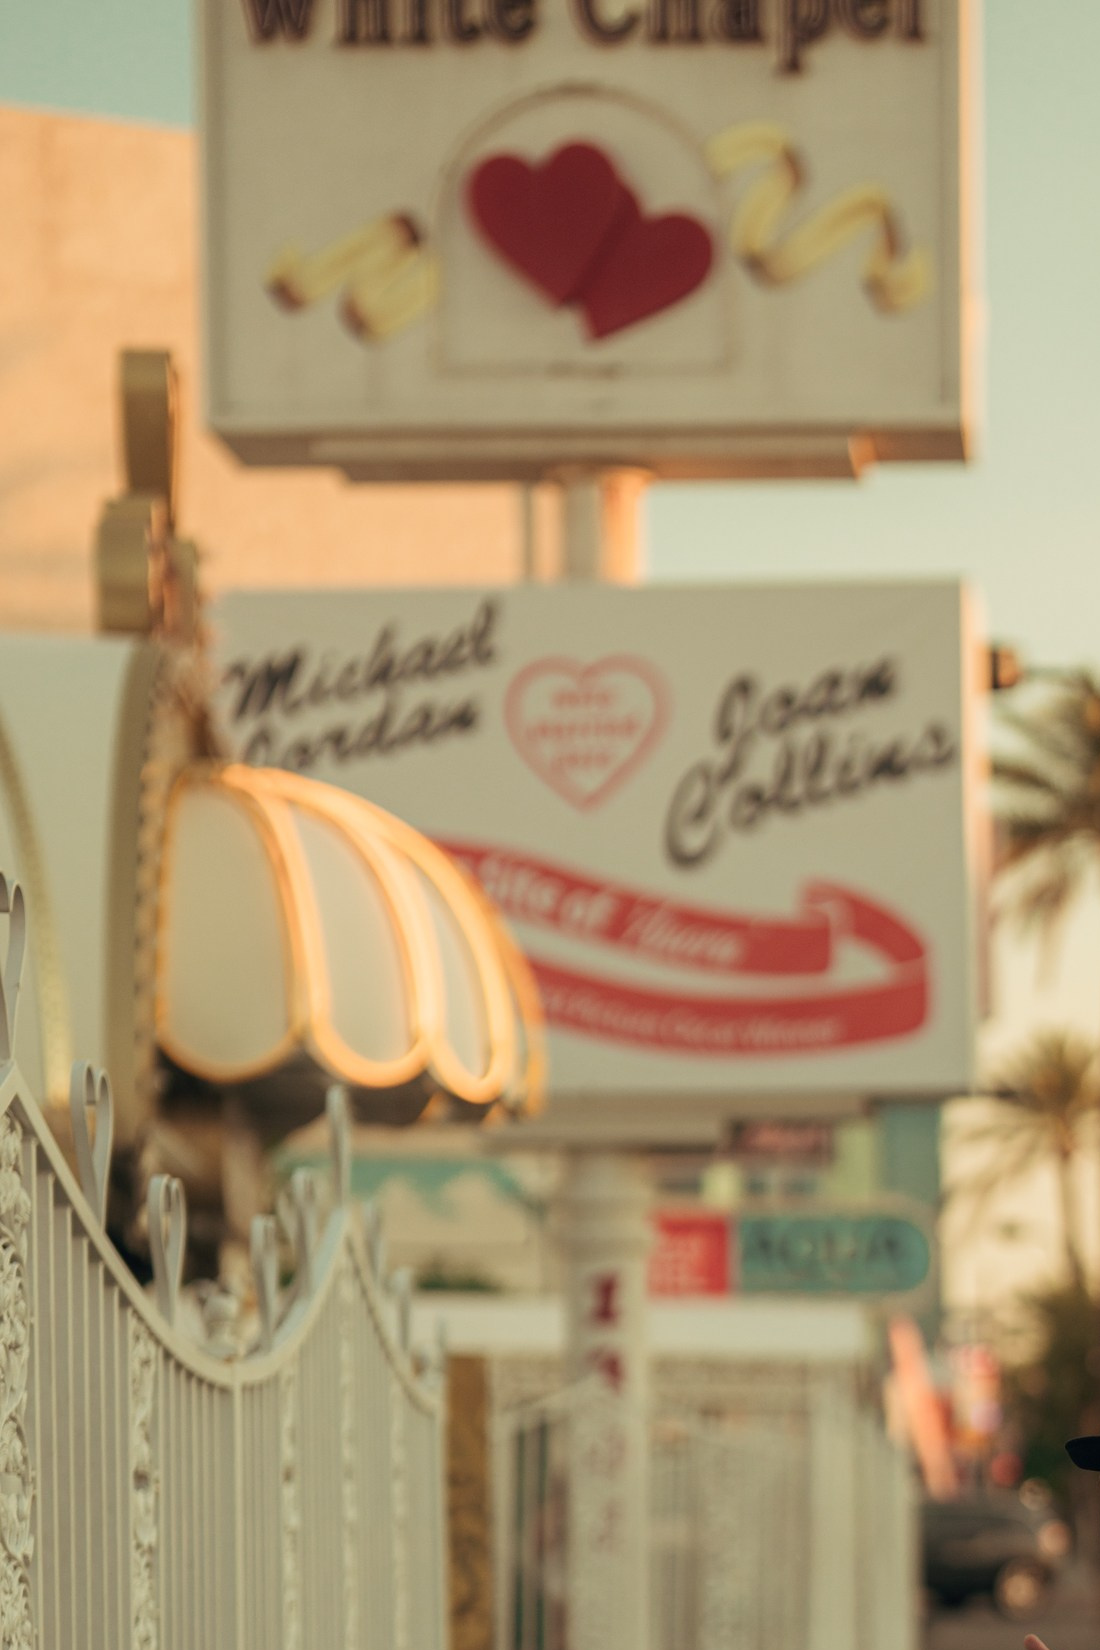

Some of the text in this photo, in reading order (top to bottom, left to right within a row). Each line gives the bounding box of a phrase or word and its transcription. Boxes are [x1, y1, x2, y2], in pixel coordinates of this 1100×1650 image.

[222, 597, 500, 722] Michael
[713, 656, 897, 790] Joan
[663, 722, 955, 870] Collins
